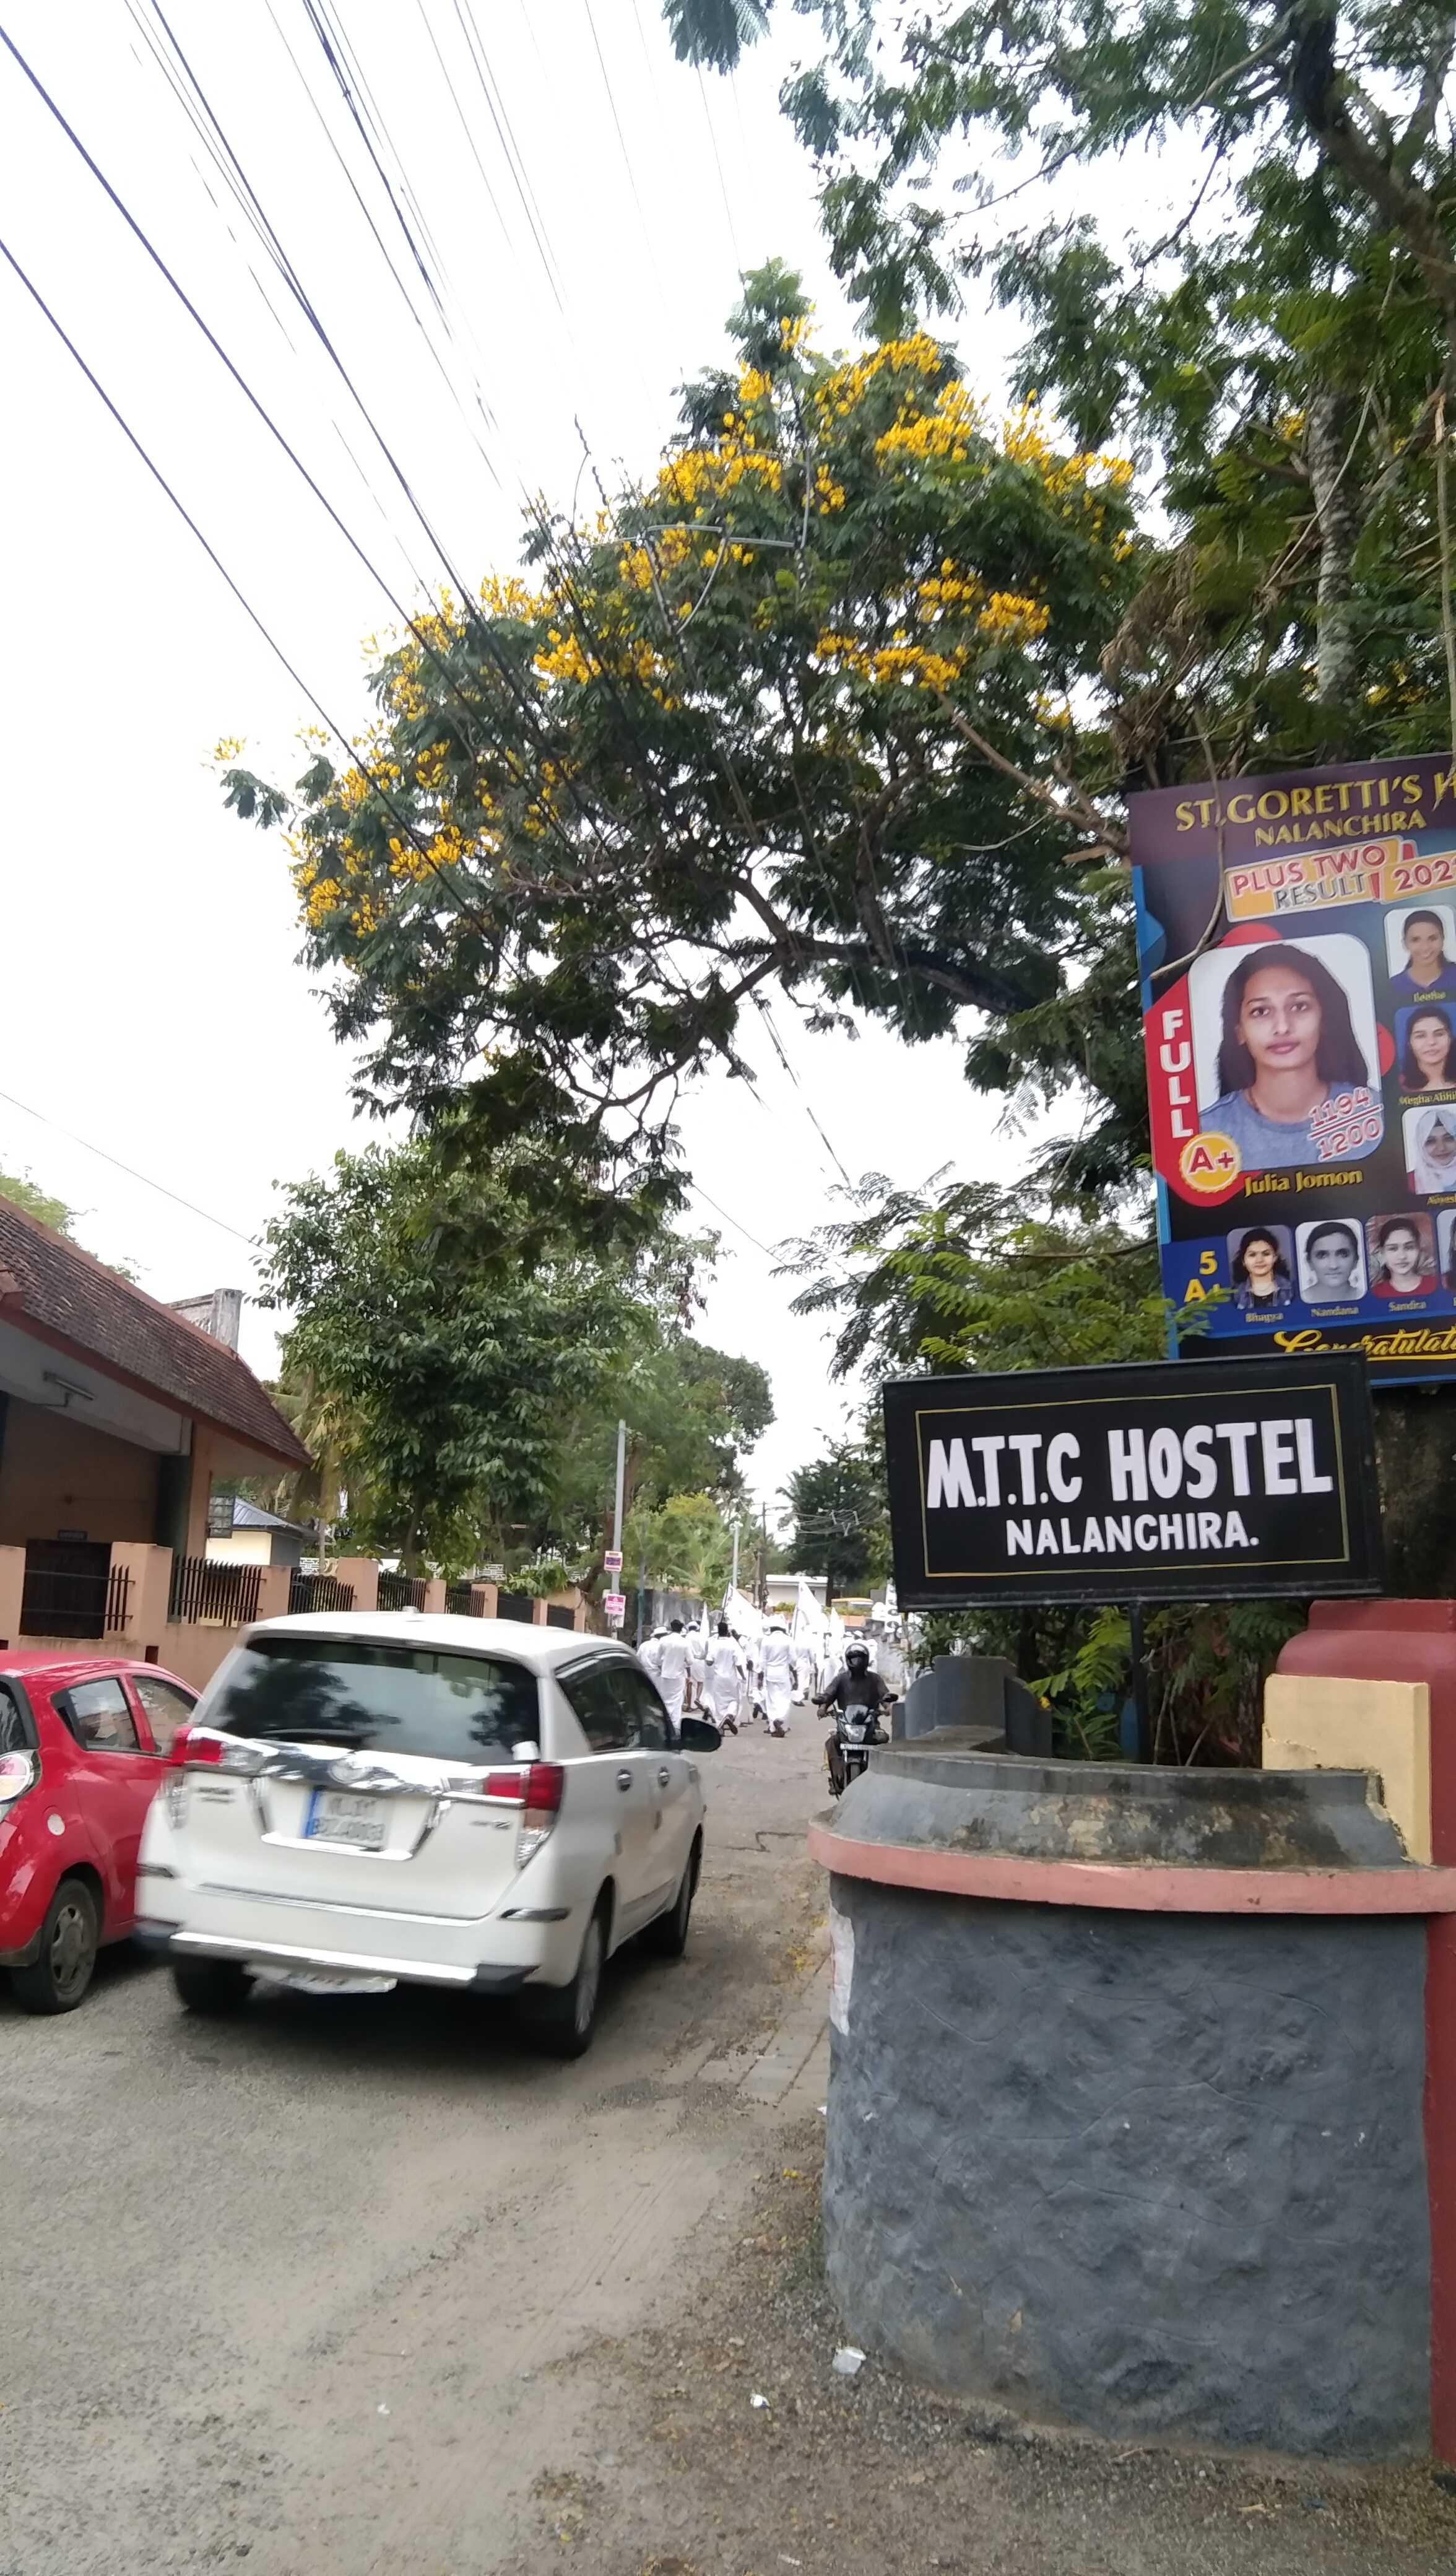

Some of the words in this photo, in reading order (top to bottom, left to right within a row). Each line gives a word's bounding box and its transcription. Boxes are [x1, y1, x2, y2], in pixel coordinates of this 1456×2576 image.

[1255, 808, 1426, 847] NALANCHIRA
[1233, 862, 1304, 897] PLUS
[1314, 845, 1385, 878] TWO
[1395, 857, 1456, 890] 202
[1274, 872, 1364, 911] RESULT
[1159, 1009, 1193, 1139] FULL
[1309, 1087, 1372, 1128] 1194
[1317, 1117, 1382, 1161] 1200
[1188, 1146, 1234, 1173] A+
[1244, 1174, 1290, 1198] Julia
[1295, 1170, 1363, 1193] Jomon
[1199, 1250, 1218, 1275] 5
[1107, 1418, 1333, 1502] HOSTEL
[1006, 1511, 1260, 1556] NALANCHIRA.
